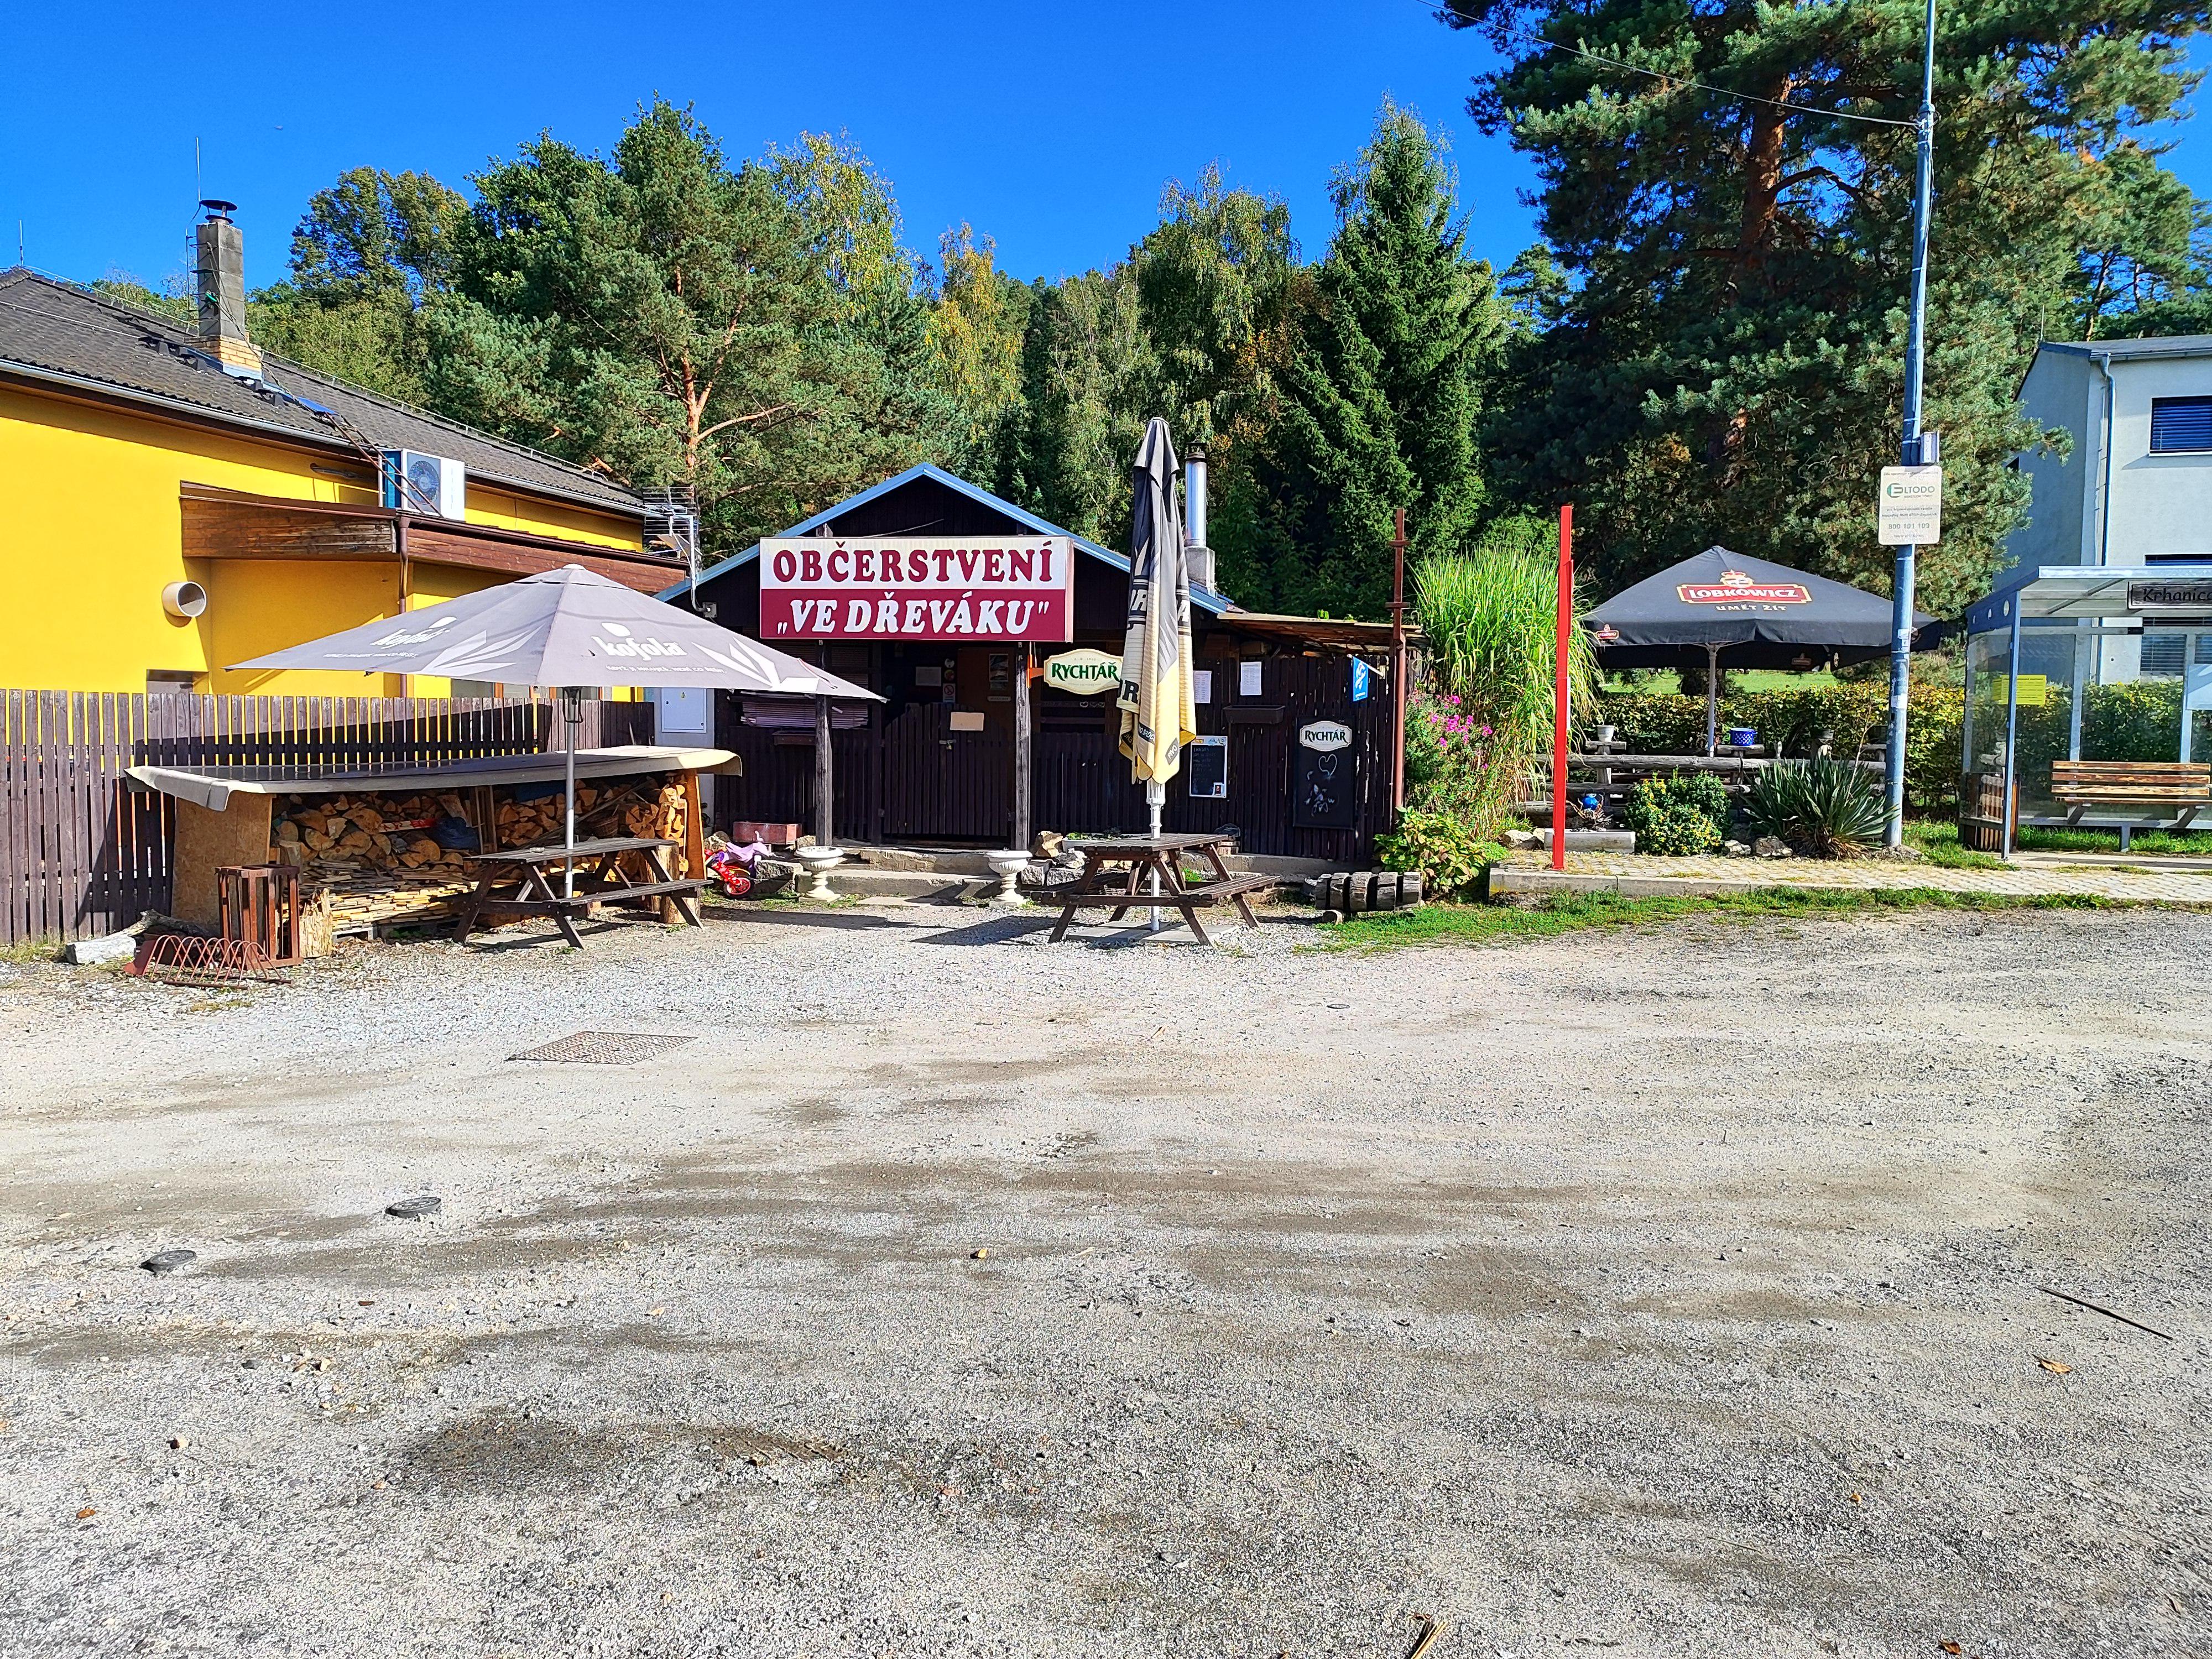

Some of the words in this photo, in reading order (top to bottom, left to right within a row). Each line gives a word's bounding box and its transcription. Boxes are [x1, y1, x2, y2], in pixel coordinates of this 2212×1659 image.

[773, 541, 1052, 583] OBČERSTVENÍ
[1688, 588, 1799, 599] LOBKOWICZ
[591, 636, 688, 661] kofola
[1051, 661, 1121, 682] RYCHTÁŘ
[1304, 729, 1348, 743] RYCHTÁŘ
